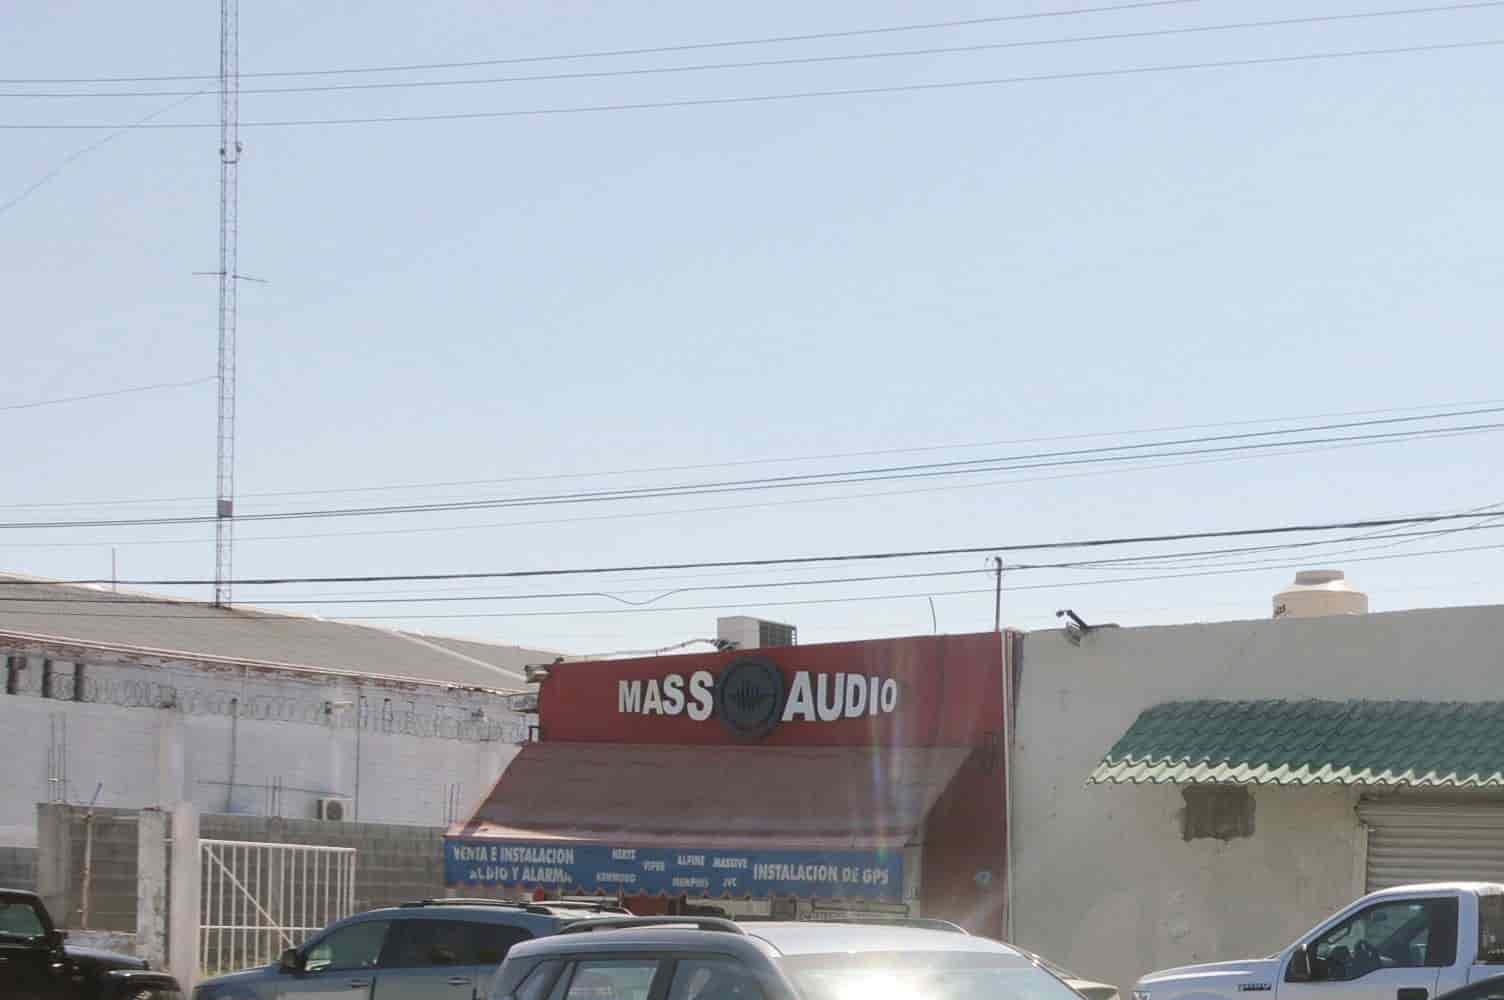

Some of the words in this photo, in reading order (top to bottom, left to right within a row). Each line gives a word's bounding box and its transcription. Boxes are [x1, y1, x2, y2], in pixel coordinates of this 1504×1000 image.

[618, 671, 714, 721] MASS
[782, 671, 897, 721] AUDIO
[454, 847, 488, 861] VENTA
[490, 847, 497, 861] E
[500, 848, 574, 864] INSTALACION
[512, 867, 520, 881] Y
[753, 864, 837, 881] INSTALACION
[842, 867, 858, 883] DE
[862, 868, 889, 885] GPS
